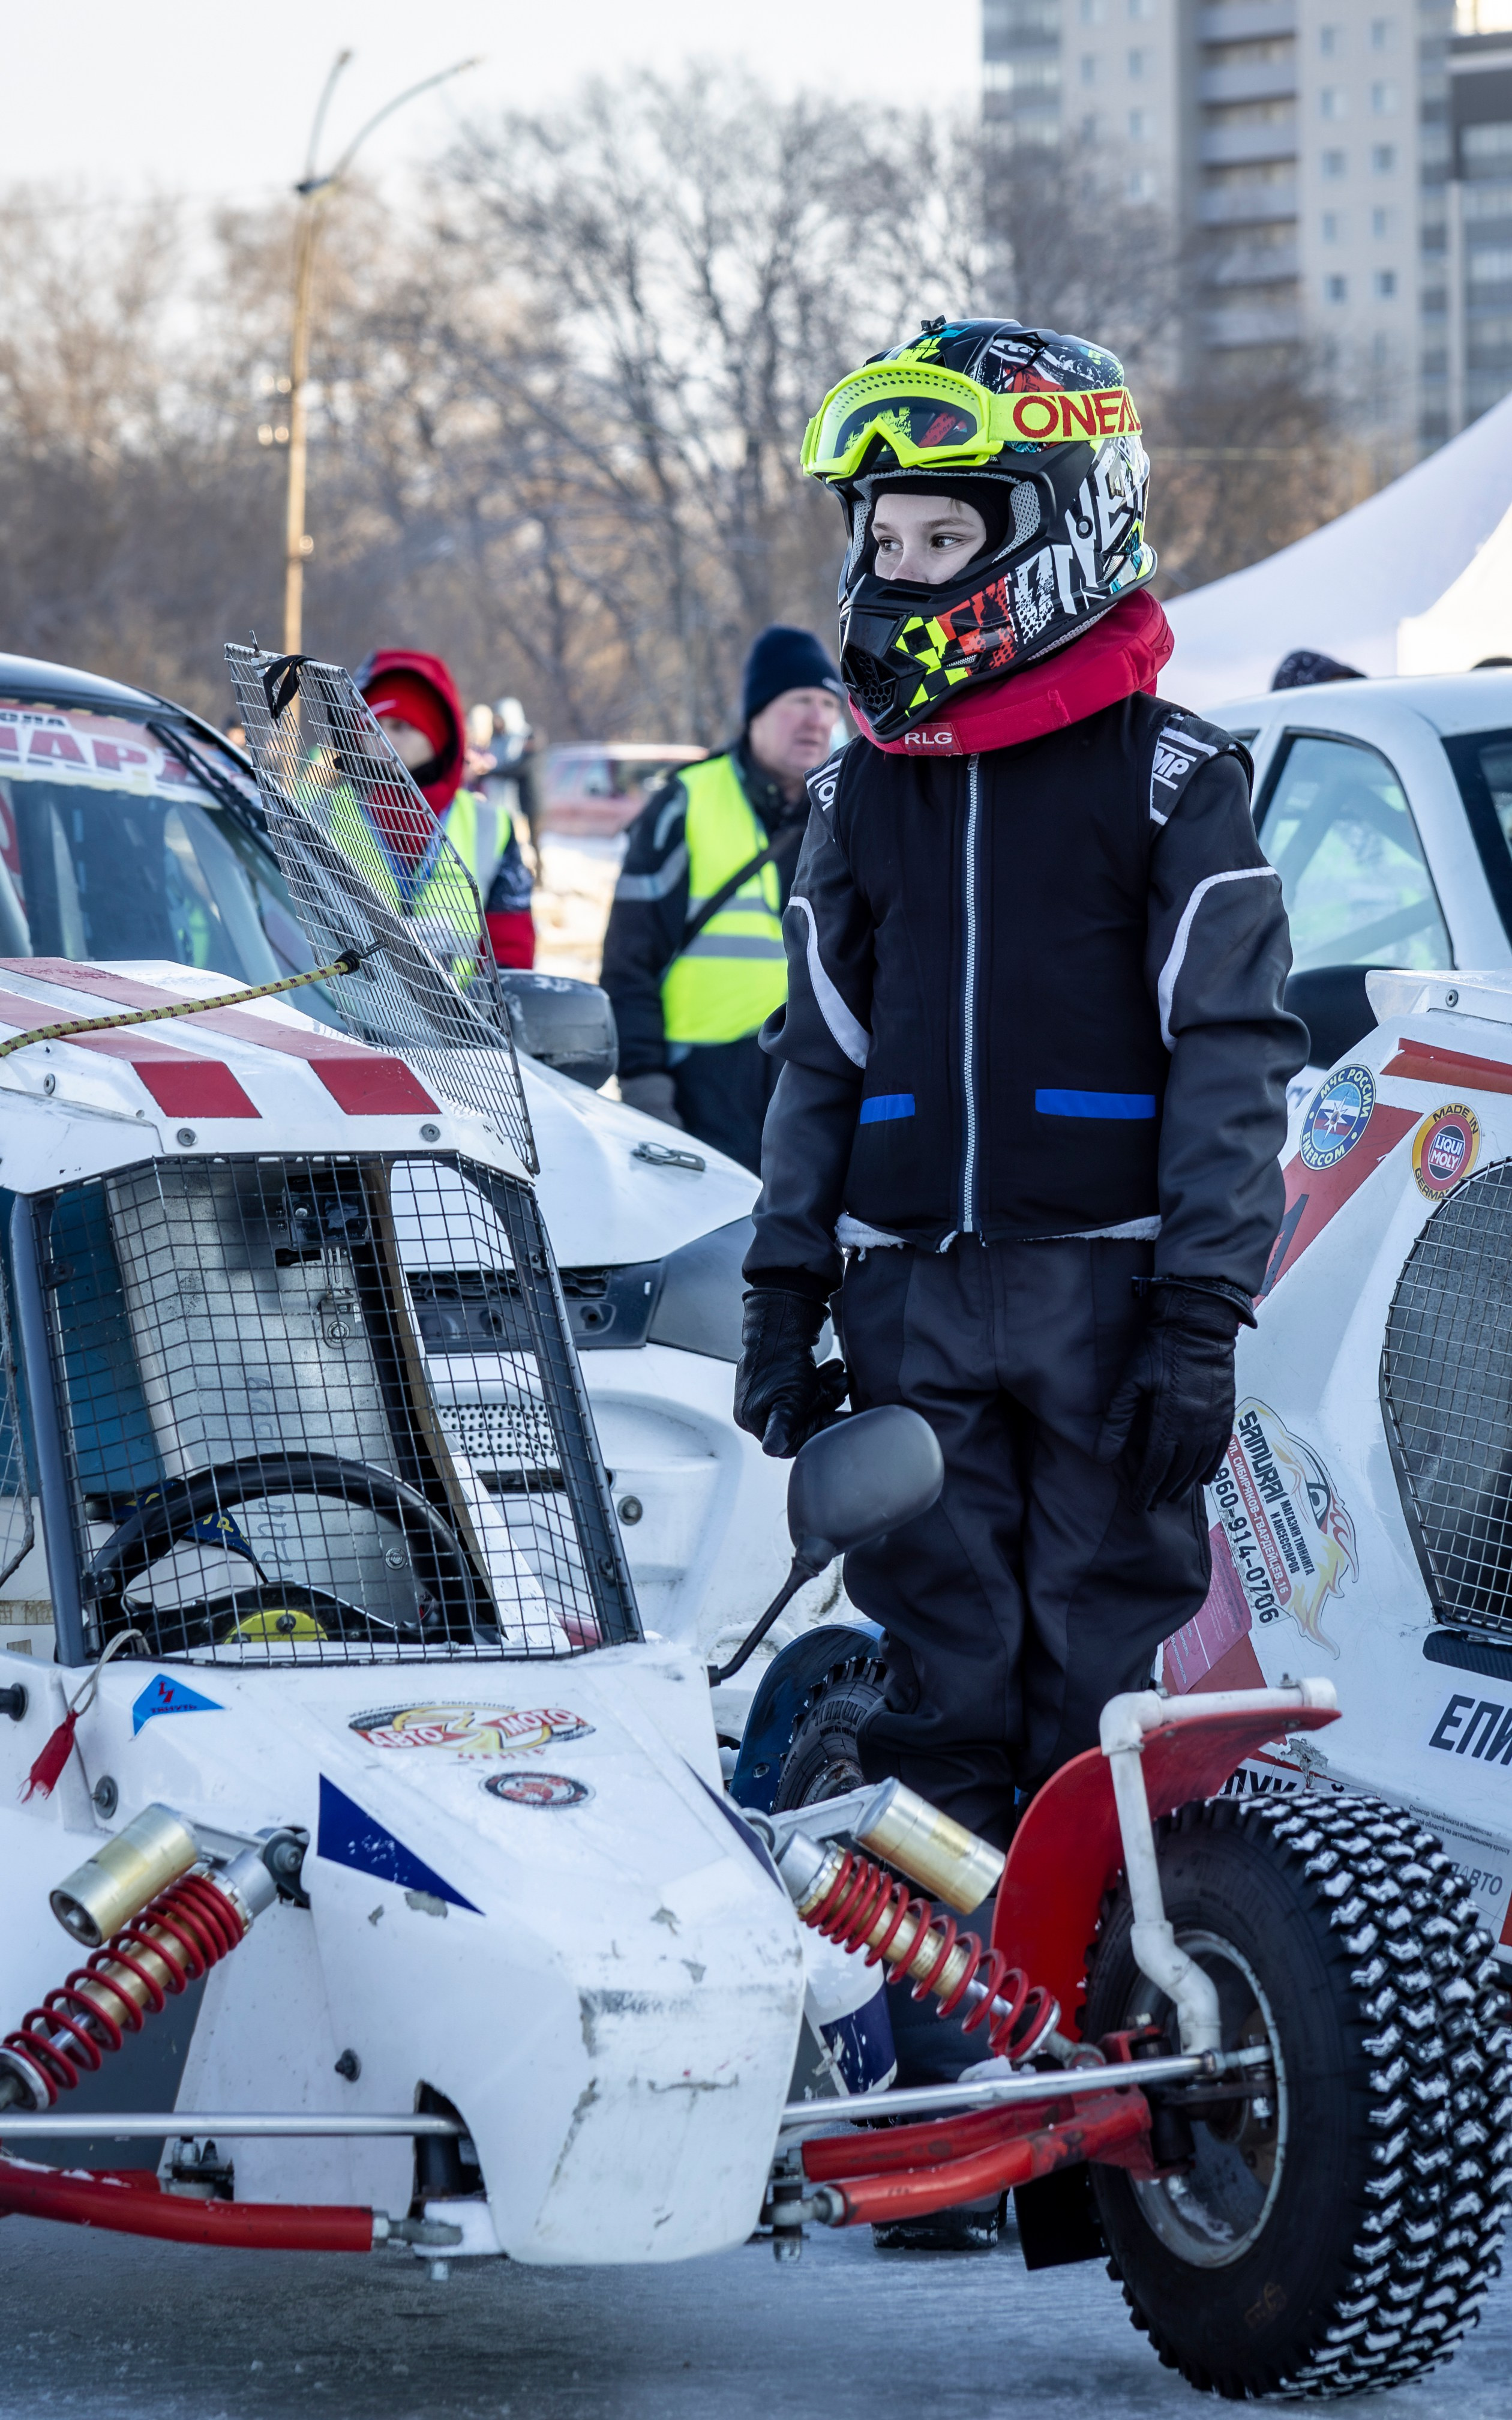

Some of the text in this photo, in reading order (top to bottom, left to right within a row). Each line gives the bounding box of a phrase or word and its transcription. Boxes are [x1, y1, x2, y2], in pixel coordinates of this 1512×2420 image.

[904, 732, 953, 745] RLG
[1320, 1070, 1346, 1100] МЧС
[1346, 1068, 1373, 1118] РОССИИ
[1432, 1104, 1478, 1134] MADE IN
[1302, 1131, 1345, 1166] EMERCOM
[1430, 1150, 1459, 1169] MOLY
[1435, 1136, 1464, 1155] LIQUI
[1415, 1167, 1451, 1200] GERMA
[1238, 1410, 1289, 1505] SAMURAI
[1272, 1519, 1300, 1574] АКСЕССУАРОВ
[1279, 1499, 1315, 1576] МАГАЗИН ТЮНИНГА
[500, 1708, 577, 1735] МОТО
[367, 1727, 443, 1747] АВТО
[1409, 1804, 1430, 1817] Спонсор
